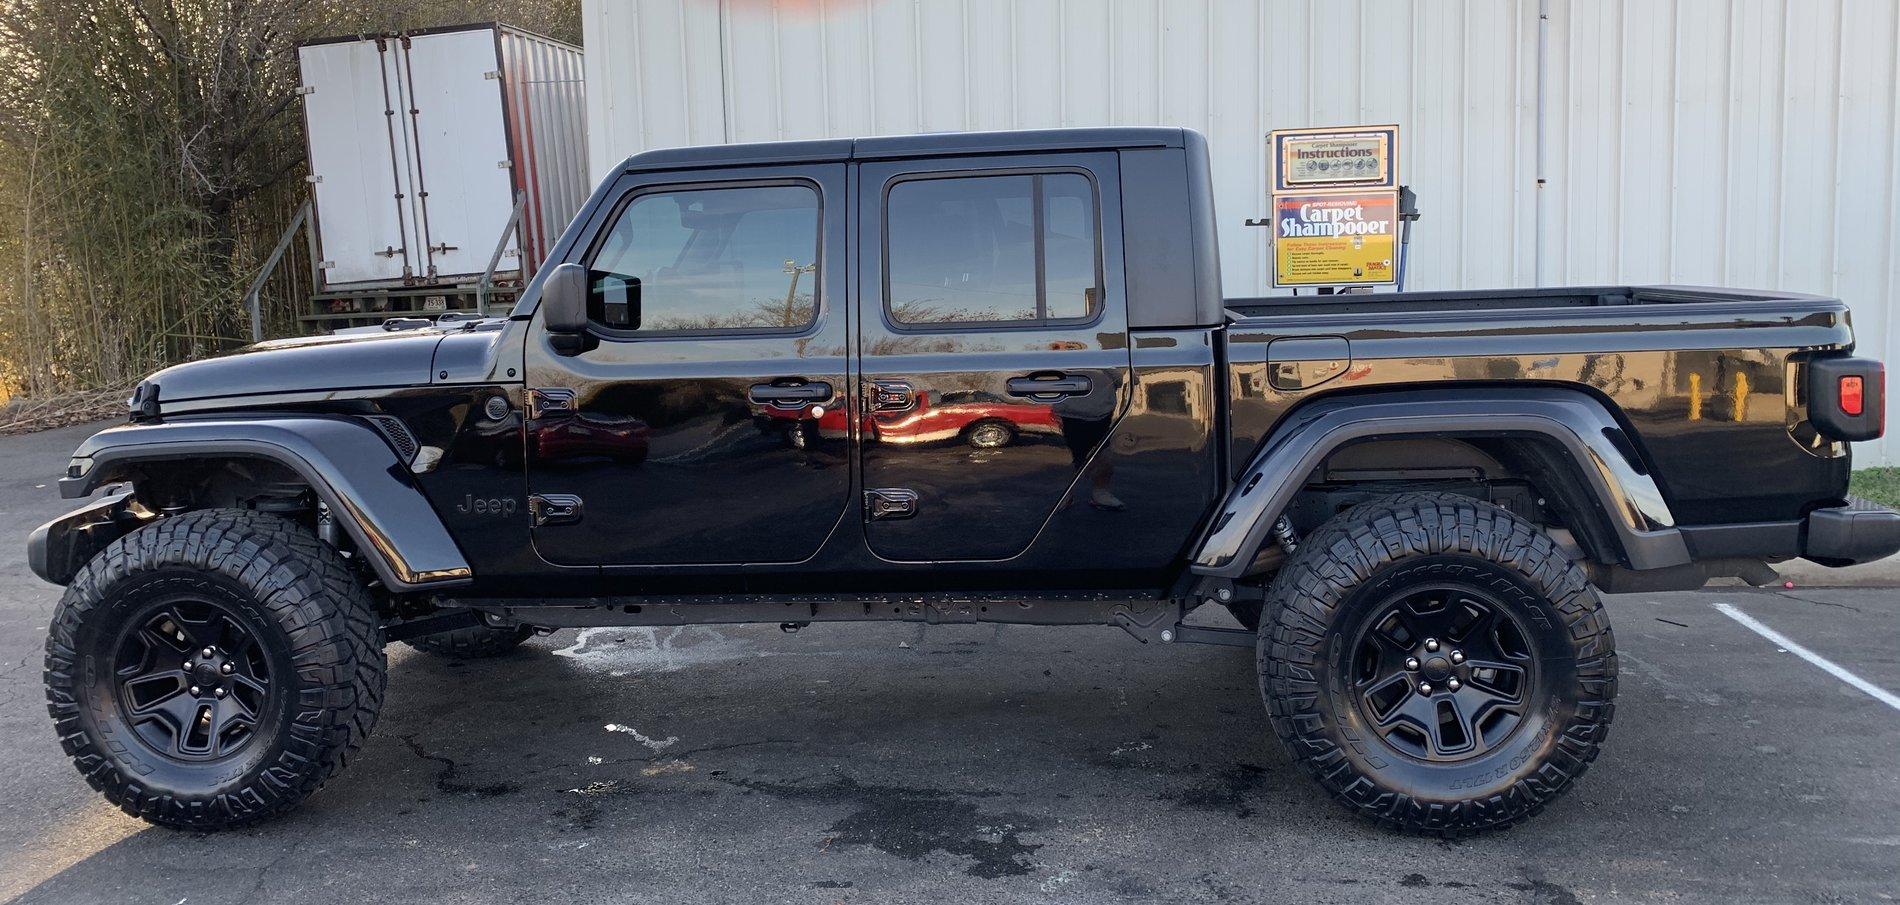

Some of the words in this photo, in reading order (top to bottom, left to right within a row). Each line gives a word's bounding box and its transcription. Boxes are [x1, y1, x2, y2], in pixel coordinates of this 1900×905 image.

[1297, 146, 1373, 160] Instructions
[1300, 203, 1363, 223] Carpet
[1281, 217, 1389, 239] Shampooer
[456, 493, 517, 519] Jeep
